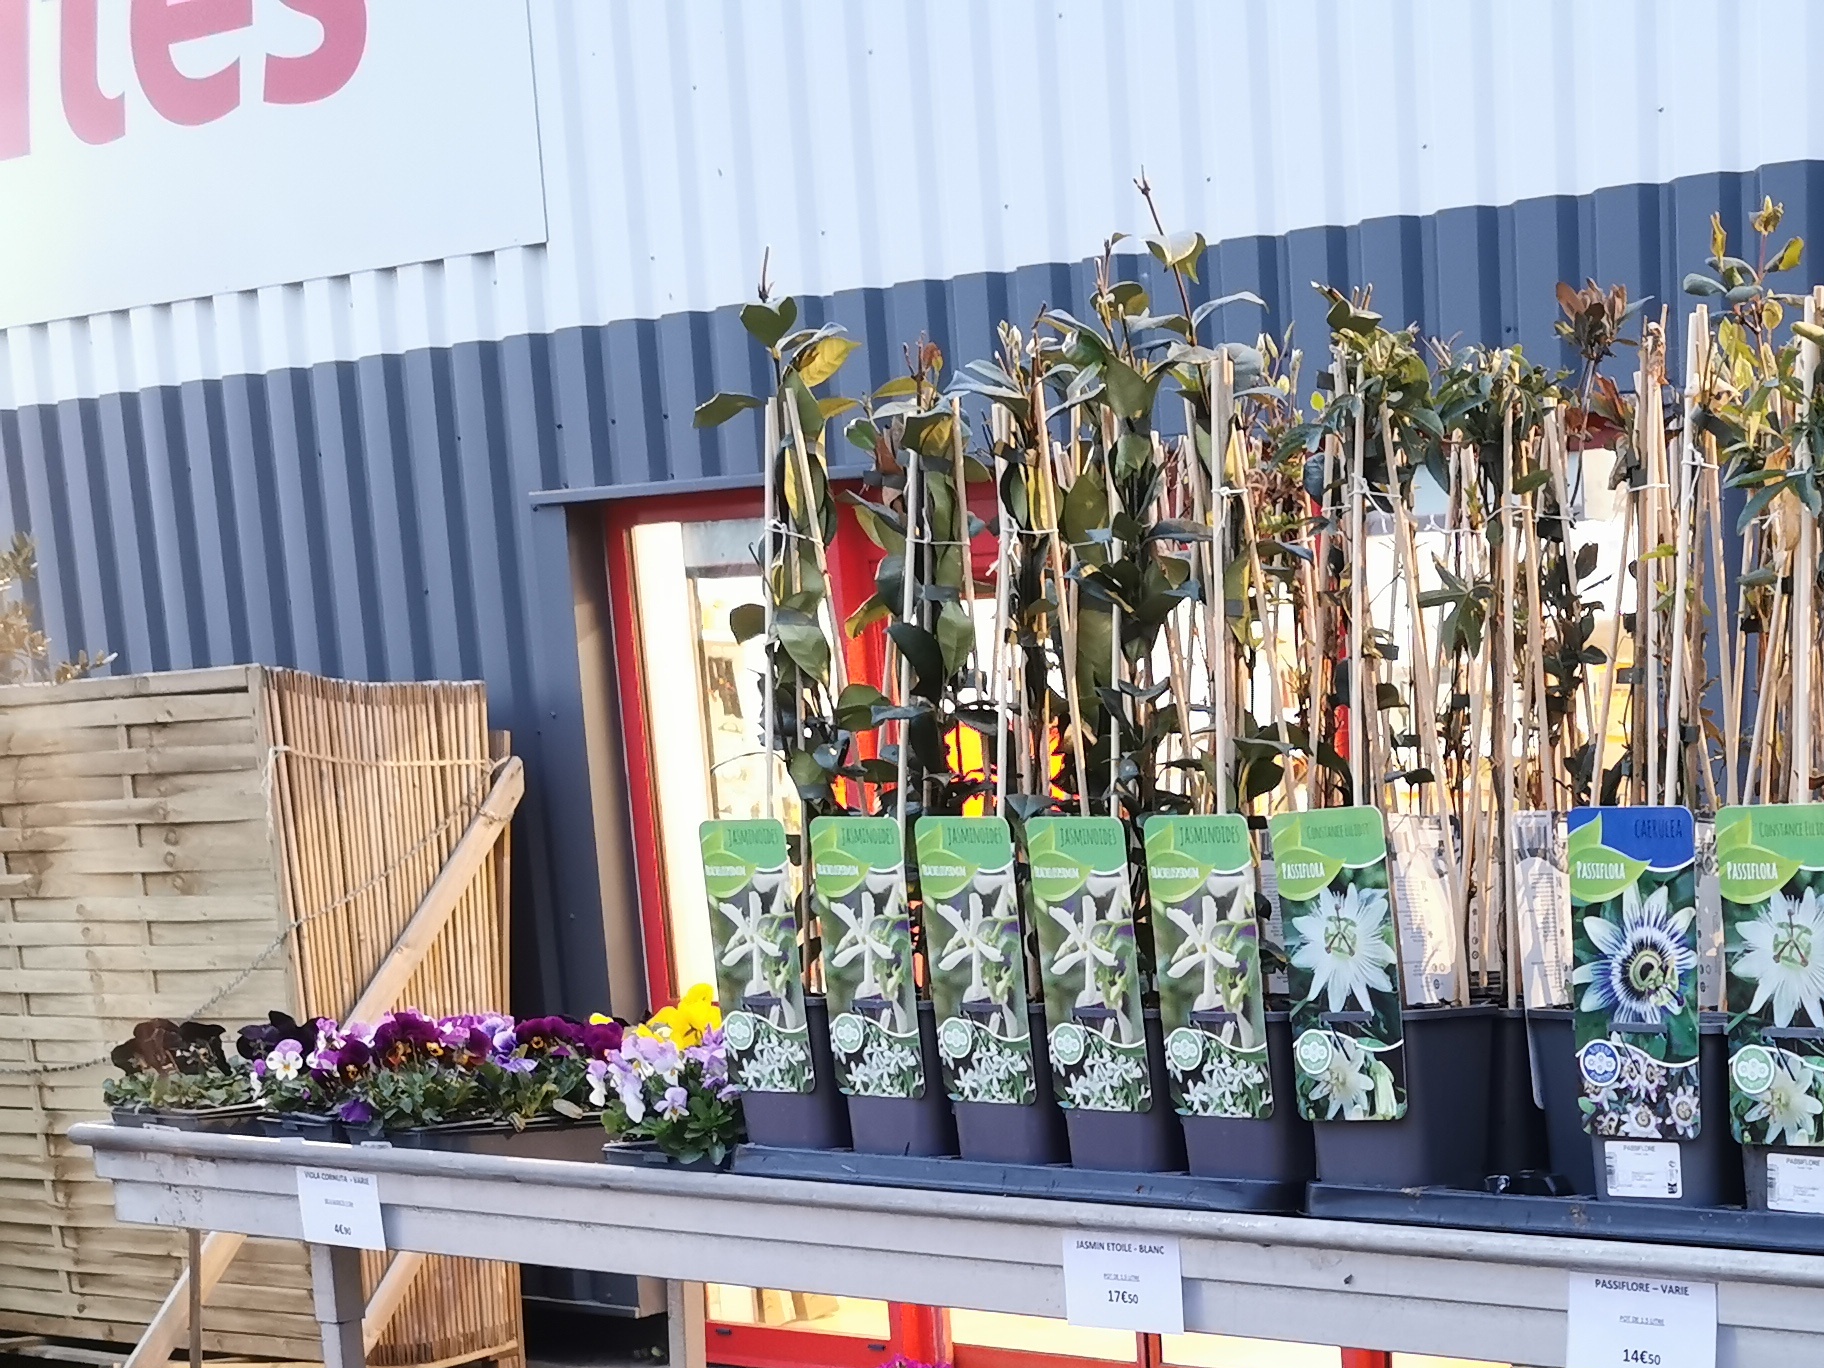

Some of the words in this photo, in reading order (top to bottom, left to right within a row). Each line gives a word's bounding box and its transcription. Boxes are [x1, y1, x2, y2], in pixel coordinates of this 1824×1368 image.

[0, 0, 368, 161] tes
[1576, 861, 1626, 880] PASSIFLORA
[1726, 861, 1779, 880] PASSIFLORA
[1076, 1240, 1105, 1251] JASMIN
[1106, 1242, 1132, 1253] ETOILE
[1139, 1244, 1165, 1255] BLANC
[1595, 1278, 1650, 1293] PASSIFLORE
[1660, 1283, 1690, 1296] VARIE
[1108, 1289, 1138, 1304] 17€50
[1622, 1348, 1661, 1365] 14€50
